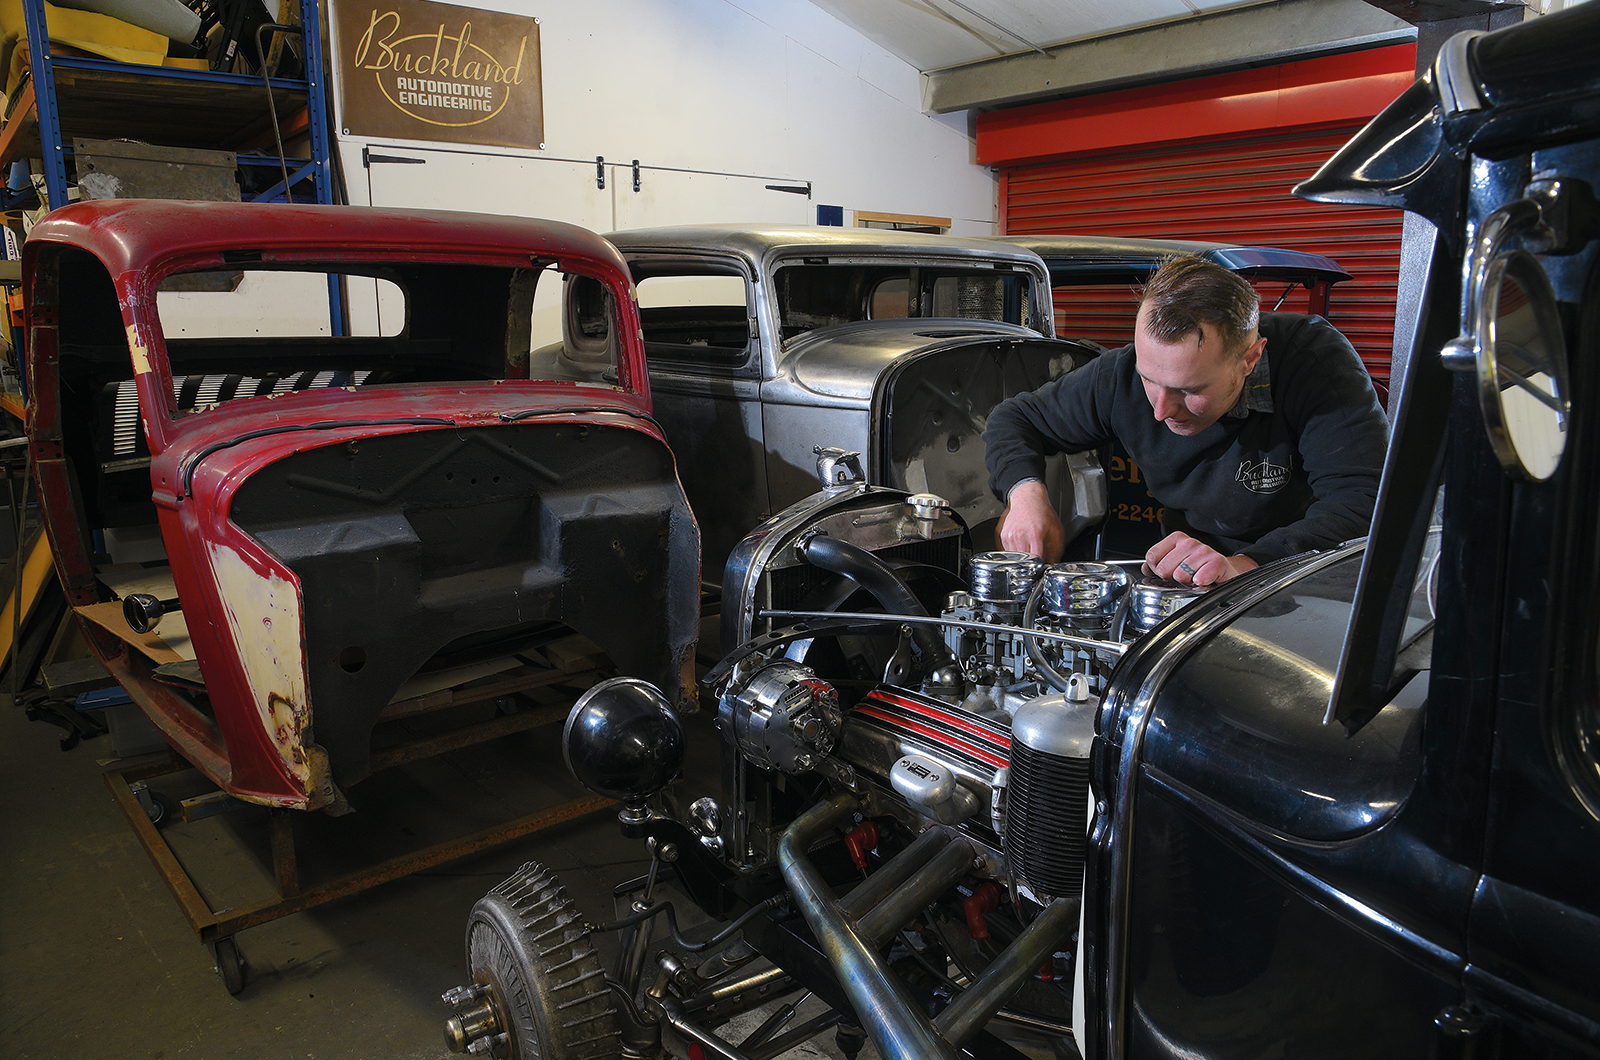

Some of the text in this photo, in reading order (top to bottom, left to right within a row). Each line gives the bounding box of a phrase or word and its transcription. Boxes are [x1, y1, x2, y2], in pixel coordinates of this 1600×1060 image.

[354, 8, 528, 85] Buckland
[397, 76, 493, 99] AUTOMOTIVE
[399, 91, 492, 112] ENGINEERING
